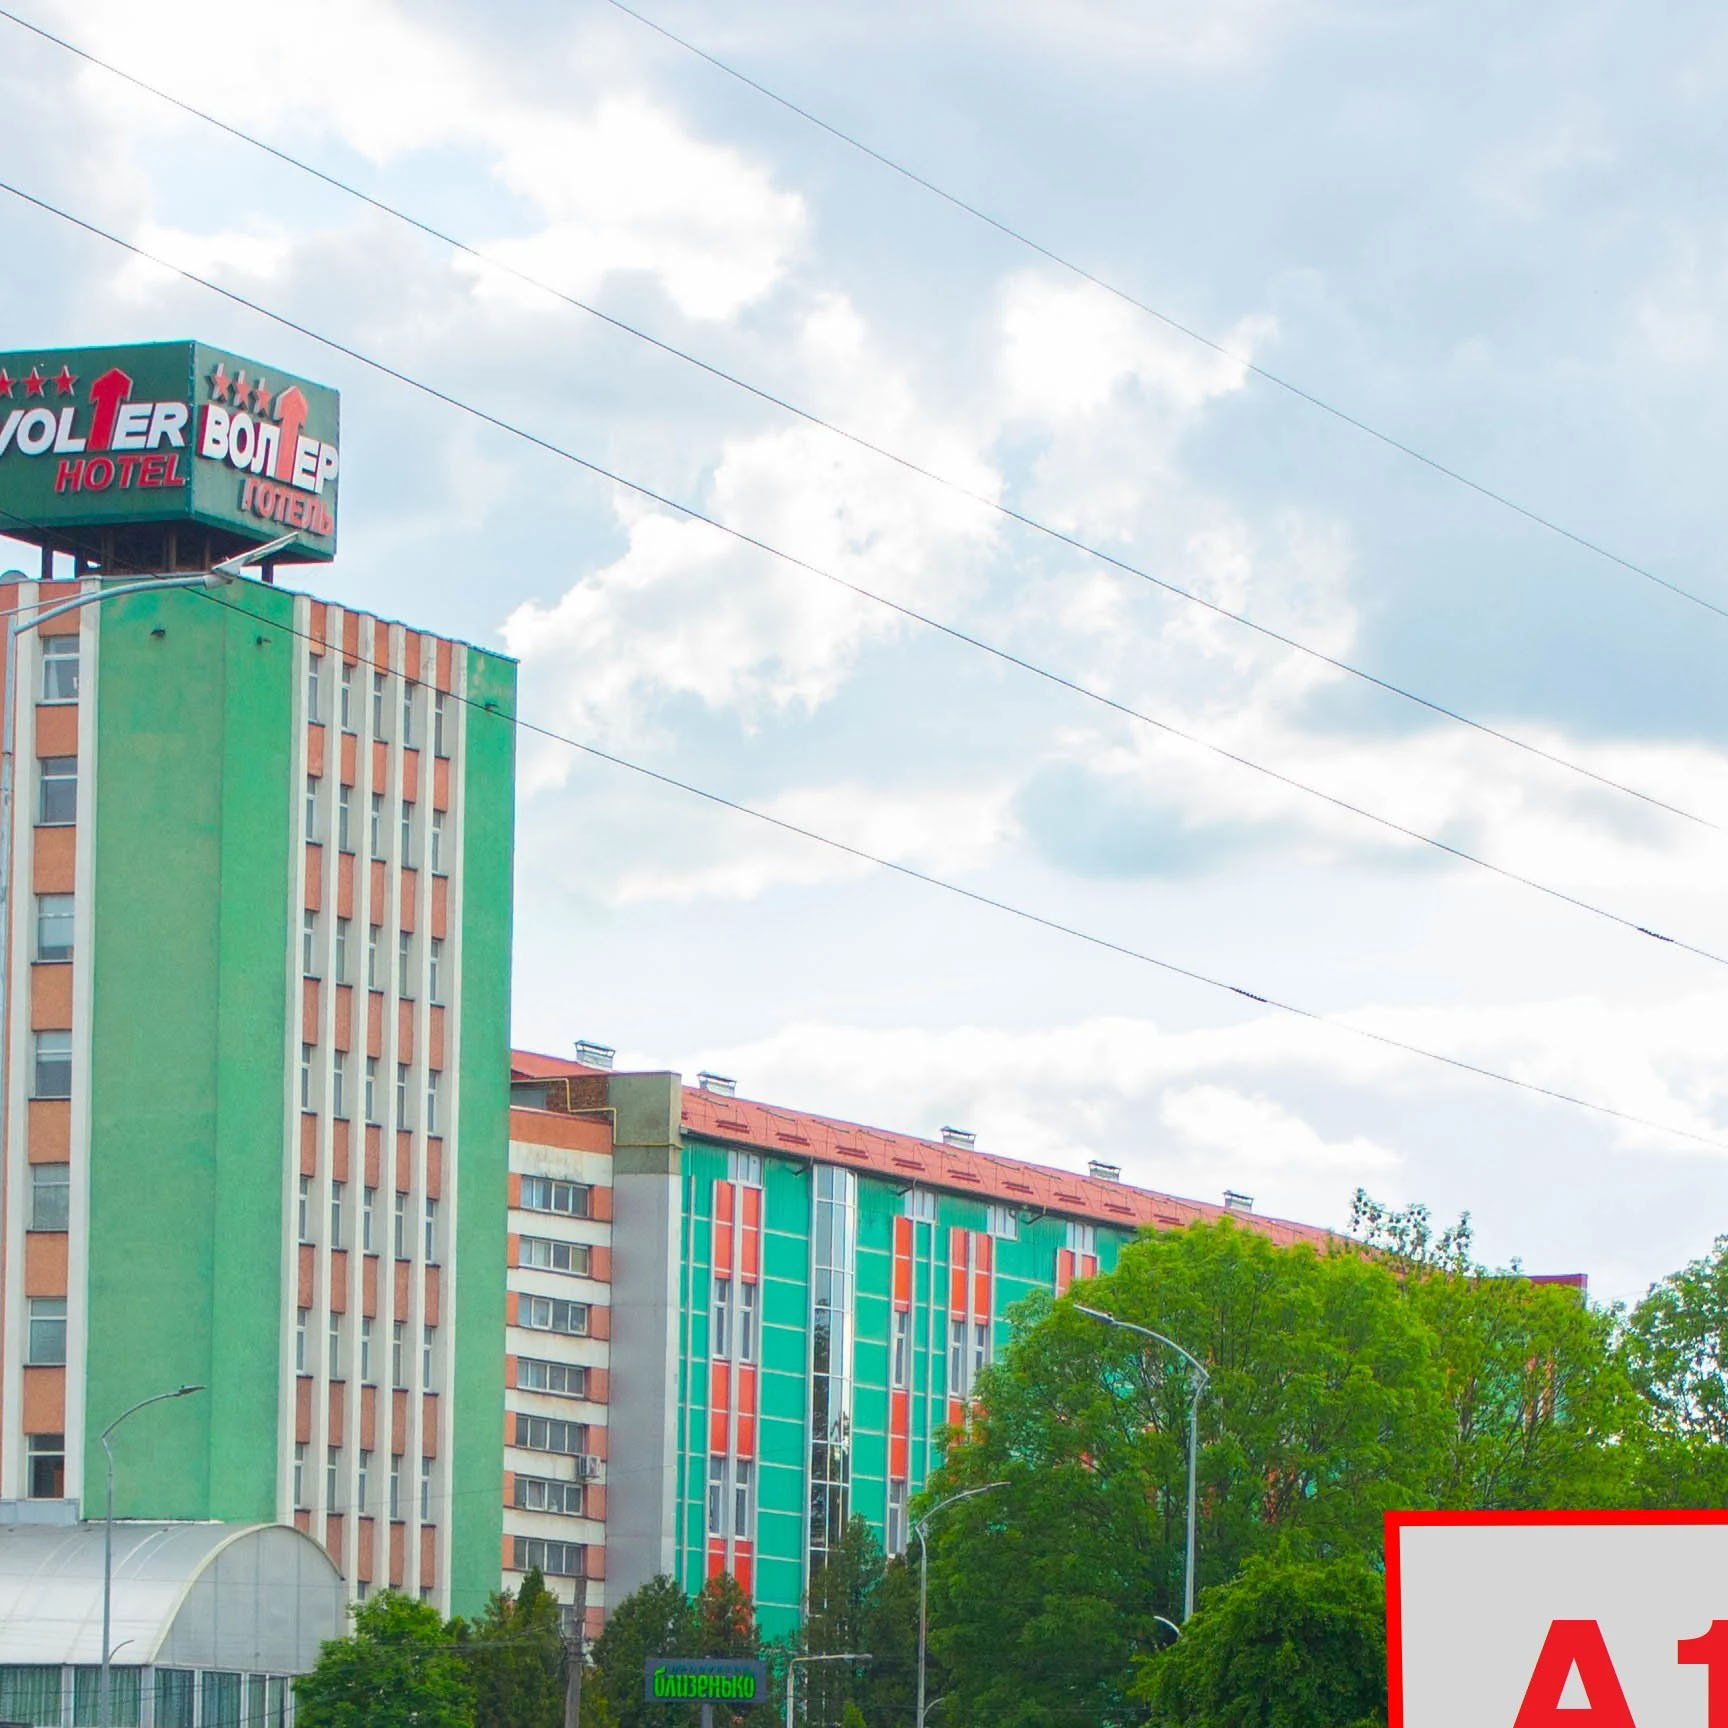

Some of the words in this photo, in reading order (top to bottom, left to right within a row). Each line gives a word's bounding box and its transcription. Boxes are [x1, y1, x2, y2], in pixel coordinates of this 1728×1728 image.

[55, 454, 186, 493] HOTEL
[241, 478, 335, 537] ГОТЕЛЬ
[654, 1666, 756, 1698] близенько
